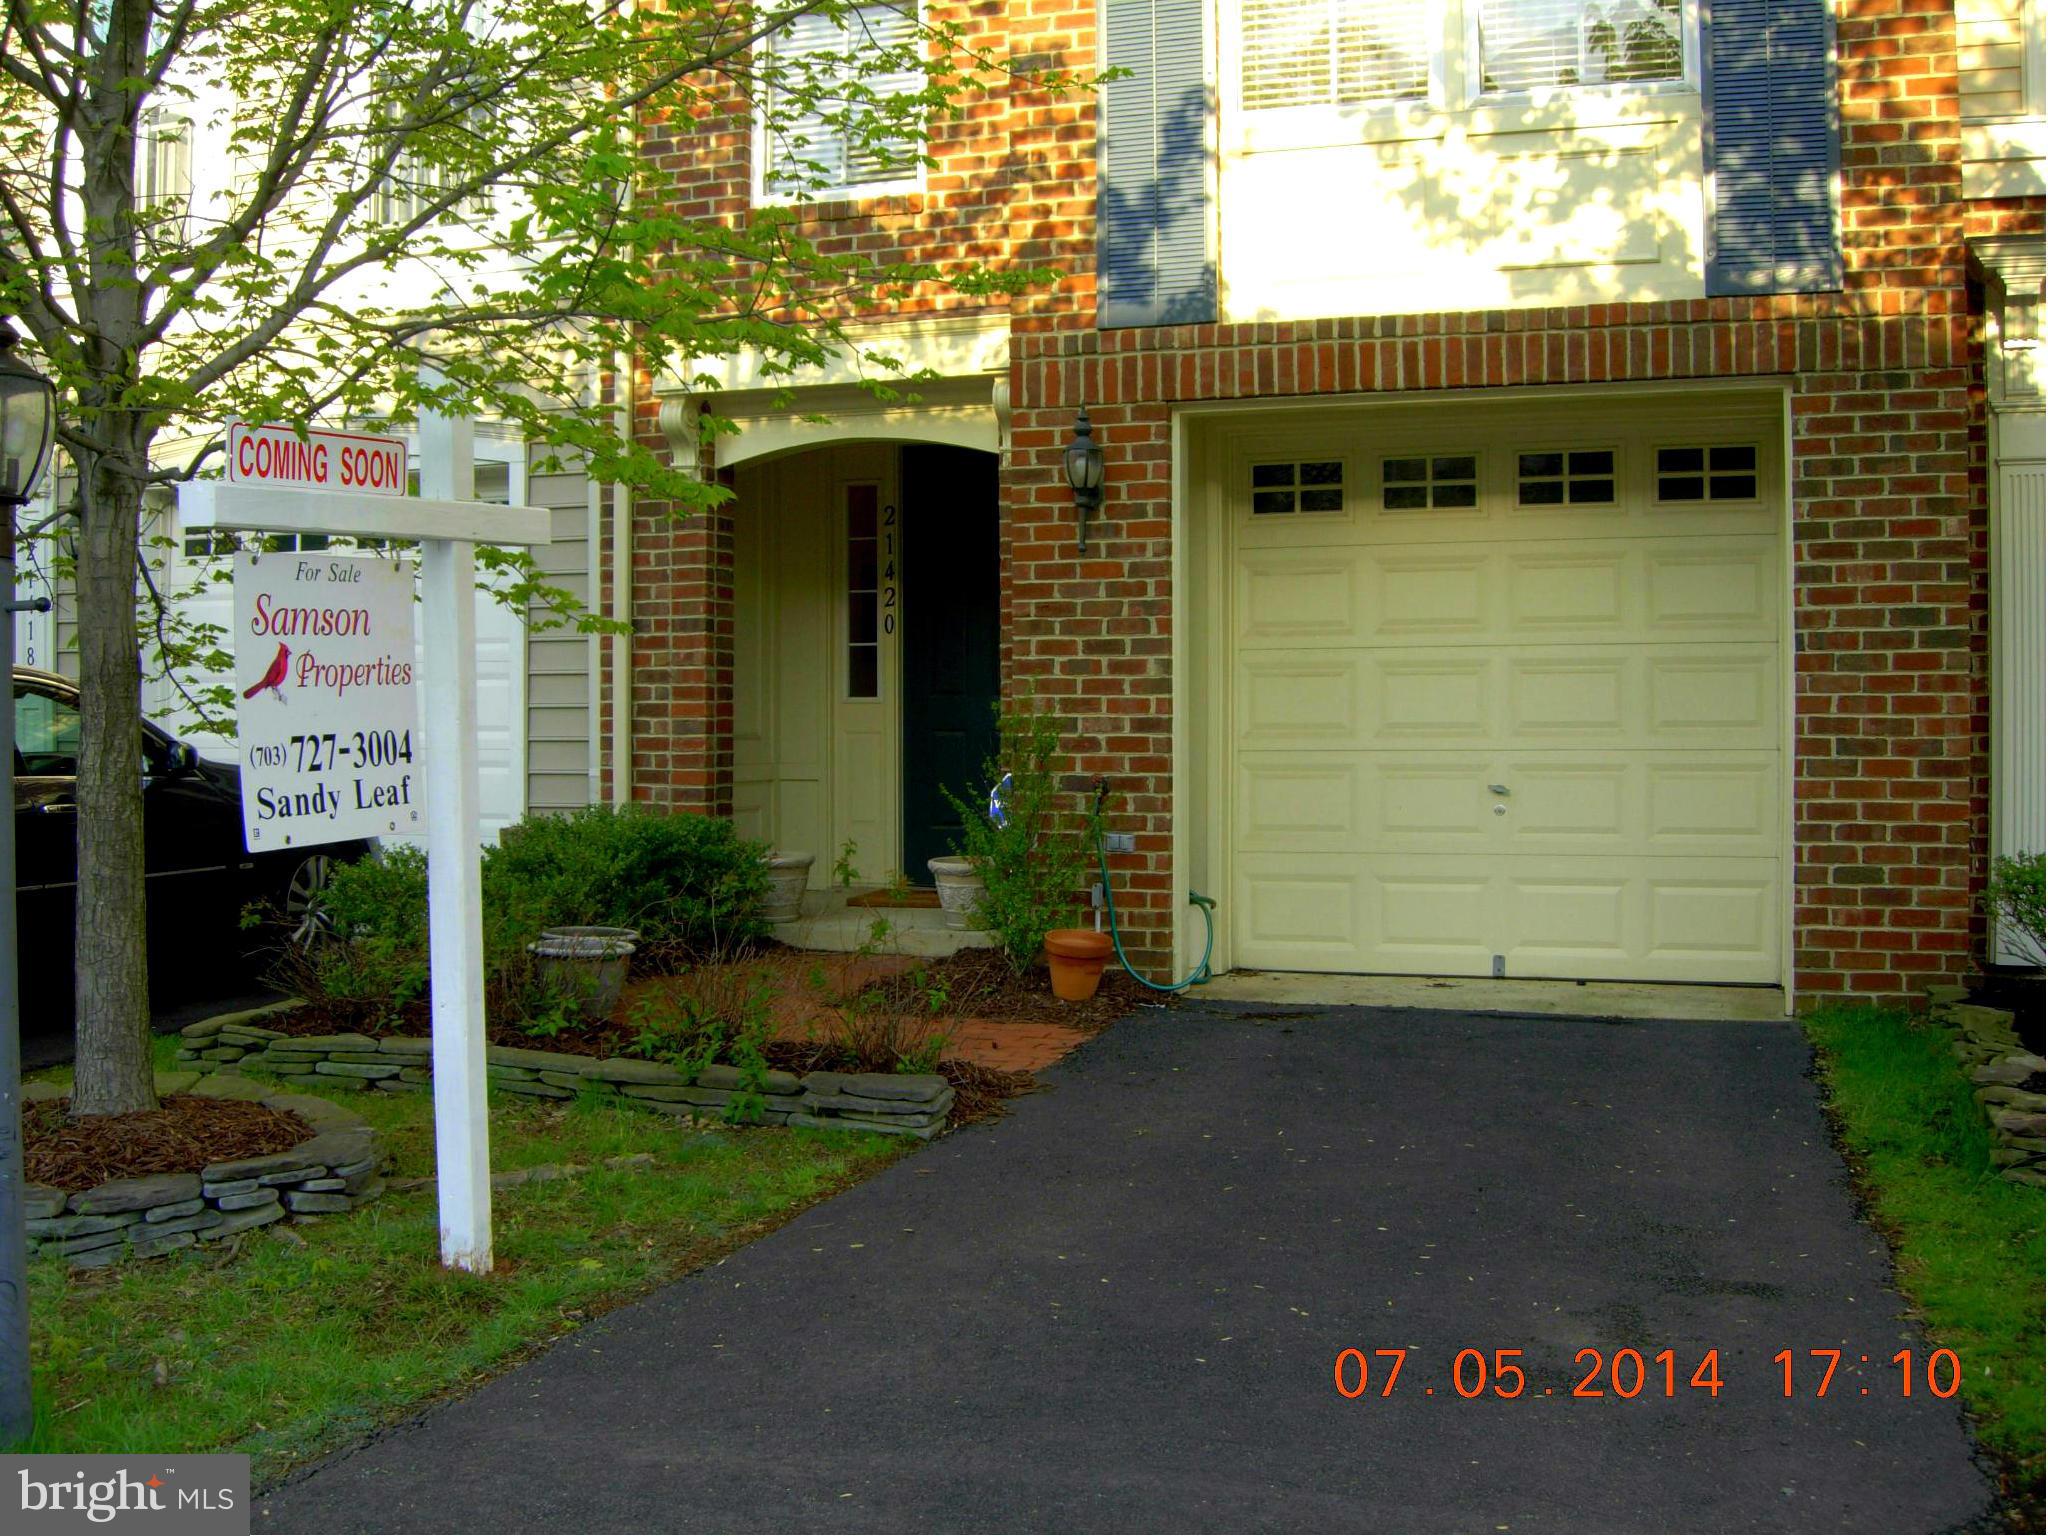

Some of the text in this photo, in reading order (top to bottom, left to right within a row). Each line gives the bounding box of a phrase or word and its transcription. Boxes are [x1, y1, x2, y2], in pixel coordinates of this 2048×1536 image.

[239, 435, 398, 489] COMING SOON
[295, 561, 361, 583] For Sale
[883, 505, 896, 635] 21420
[251, 593, 370, 636] Samson
[296, 650, 412, 697] Properties
[250, 729, 413, 773] (703) 727-3004
[257, 775, 411, 820] Sandy Leaf
